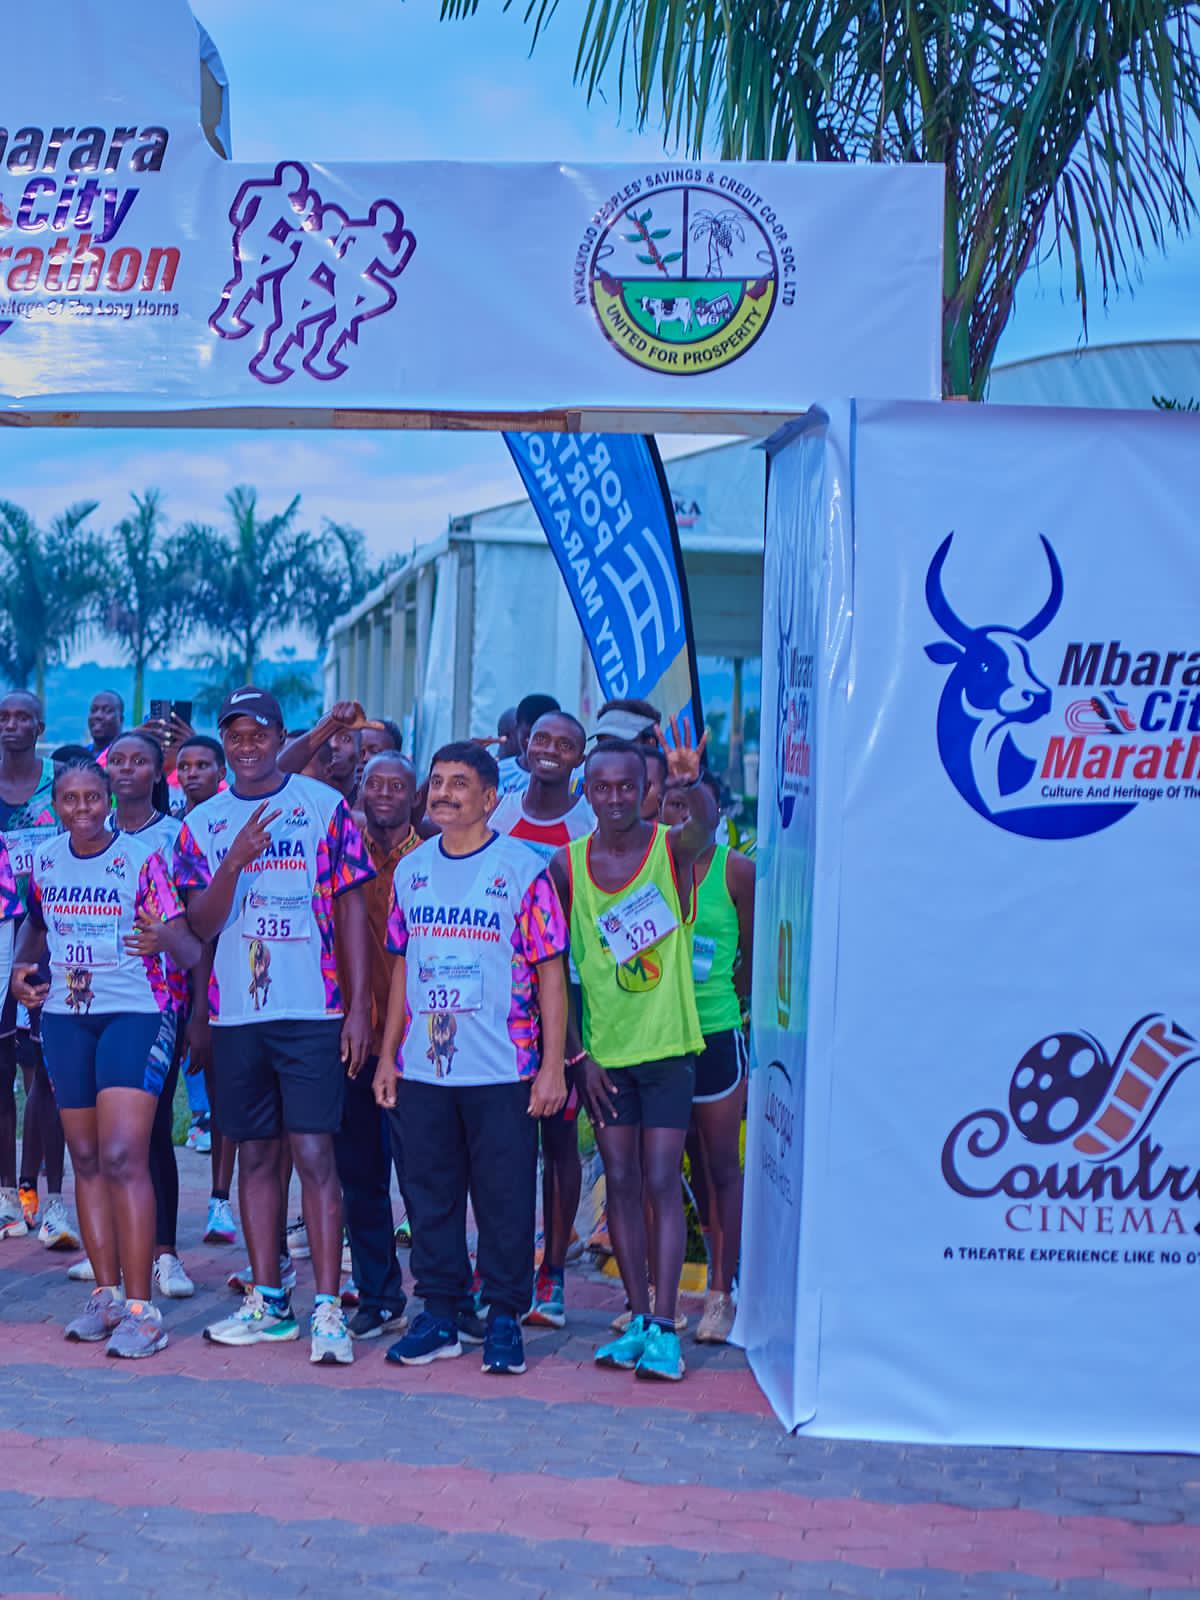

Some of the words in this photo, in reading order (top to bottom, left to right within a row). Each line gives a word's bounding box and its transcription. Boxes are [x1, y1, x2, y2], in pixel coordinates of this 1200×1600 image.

[16, 176, 140, 243] City
[646, 169, 702, 188] SAVINGS
[706, 171, 715, 183] &
[719, 175, 763, 209] CREDIT
[782, 281, 798, 306] LTD
[98, 300, 132, 320] Long
[137, 300, 180, 316] Horns
[605, 303, 648, 354] UNITED
[650, 345, 679, 365] FOR
[683, 306, 762, 365] PROSPERITY
[1041, 784, 1084, 798] Culture
[1087, 784, 1110, 798] And
[1113, 784, 1164, 801] Heritage
[1166, 784, 1182, 798] Of
[53, 904, 122, 917] MARATHON
[409, 905, 501, 931] MBARARA
[256, 917, 291, 938] 335
[432, 926, 500, 943] MARATHON
[626, 918, 657, 951] 329
[65, 944, 94, 964] 301
[428, 988, 461, 1009] 332
[941, 1108, 1200, 1204] Countr
[1004, 1203, 1189, 1235] CINEMA
[943, 1247, 954, 1260] A
[958, 1247, 1026, 1261] THEATRE
[1029, 1248, 1119, 1264] EXPERIENCE
[1123, 1250, 1155, 1264] LIKE
[1160, 1250, 1182, 1265] NO
